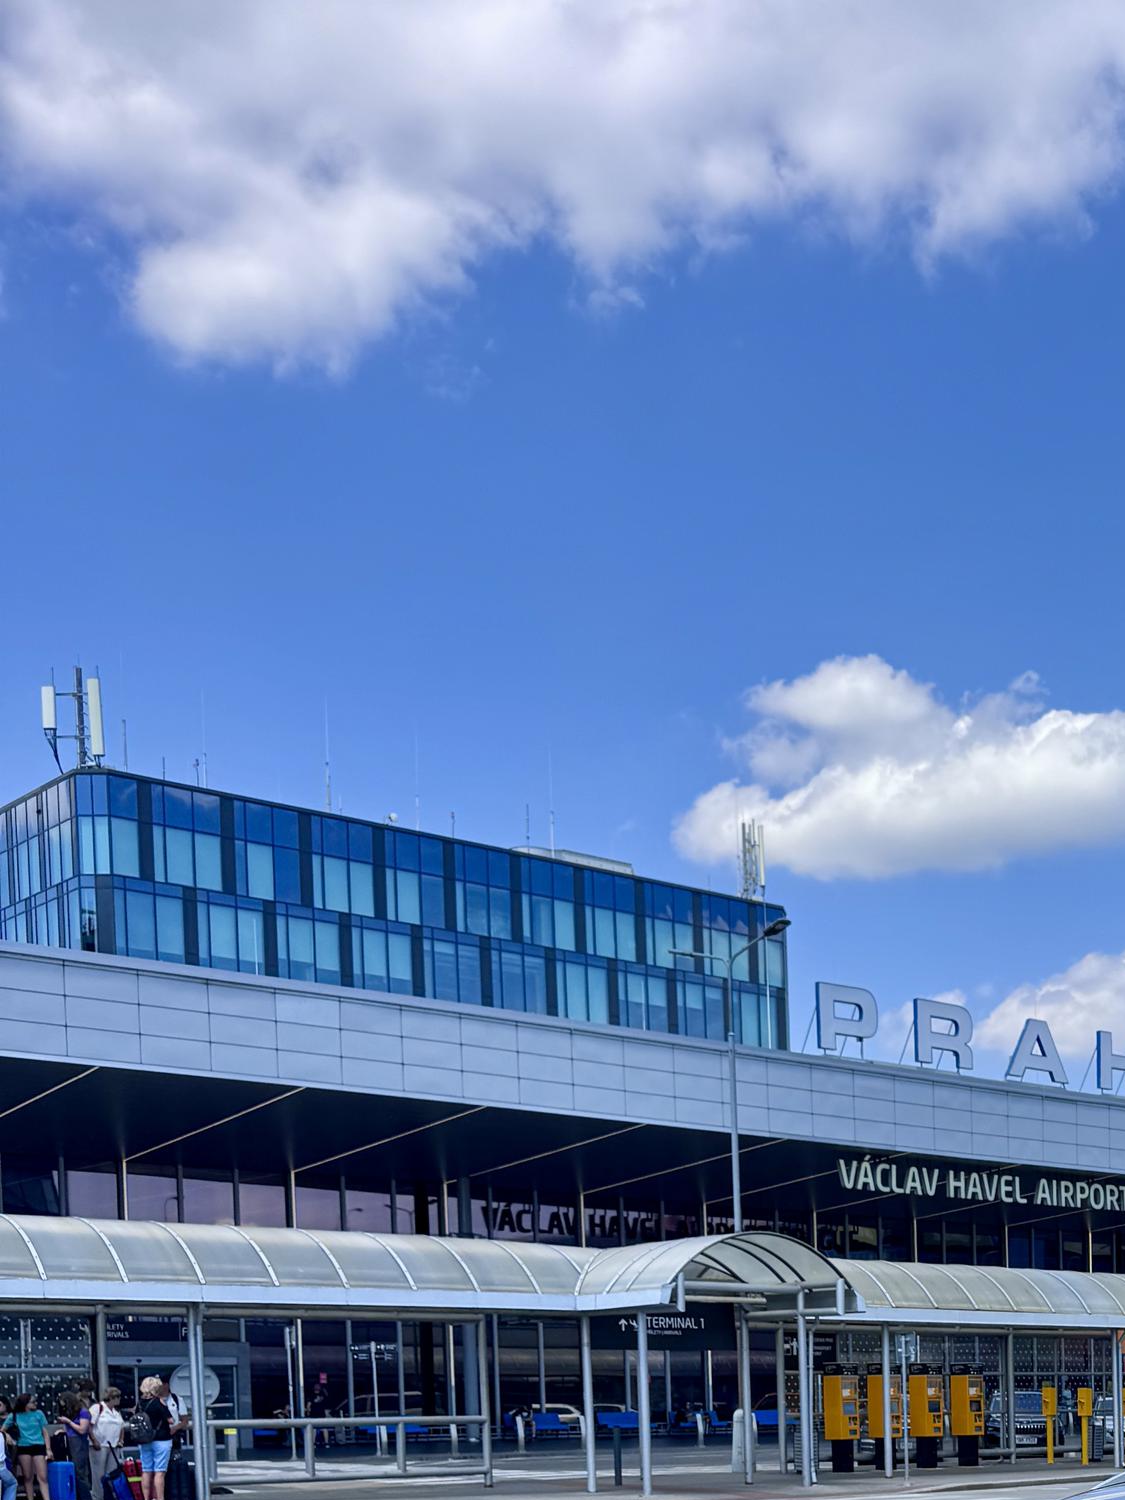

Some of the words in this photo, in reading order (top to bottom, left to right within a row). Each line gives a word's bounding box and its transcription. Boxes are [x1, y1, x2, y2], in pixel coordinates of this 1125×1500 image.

[837, 1154, 939, 1197] VÁCLAV
[946, 1169, 1027, 1204] HAVEL
[646, 1316, 698, 1329] TERMINAL
[700, 1317, 705, 1329] 1
